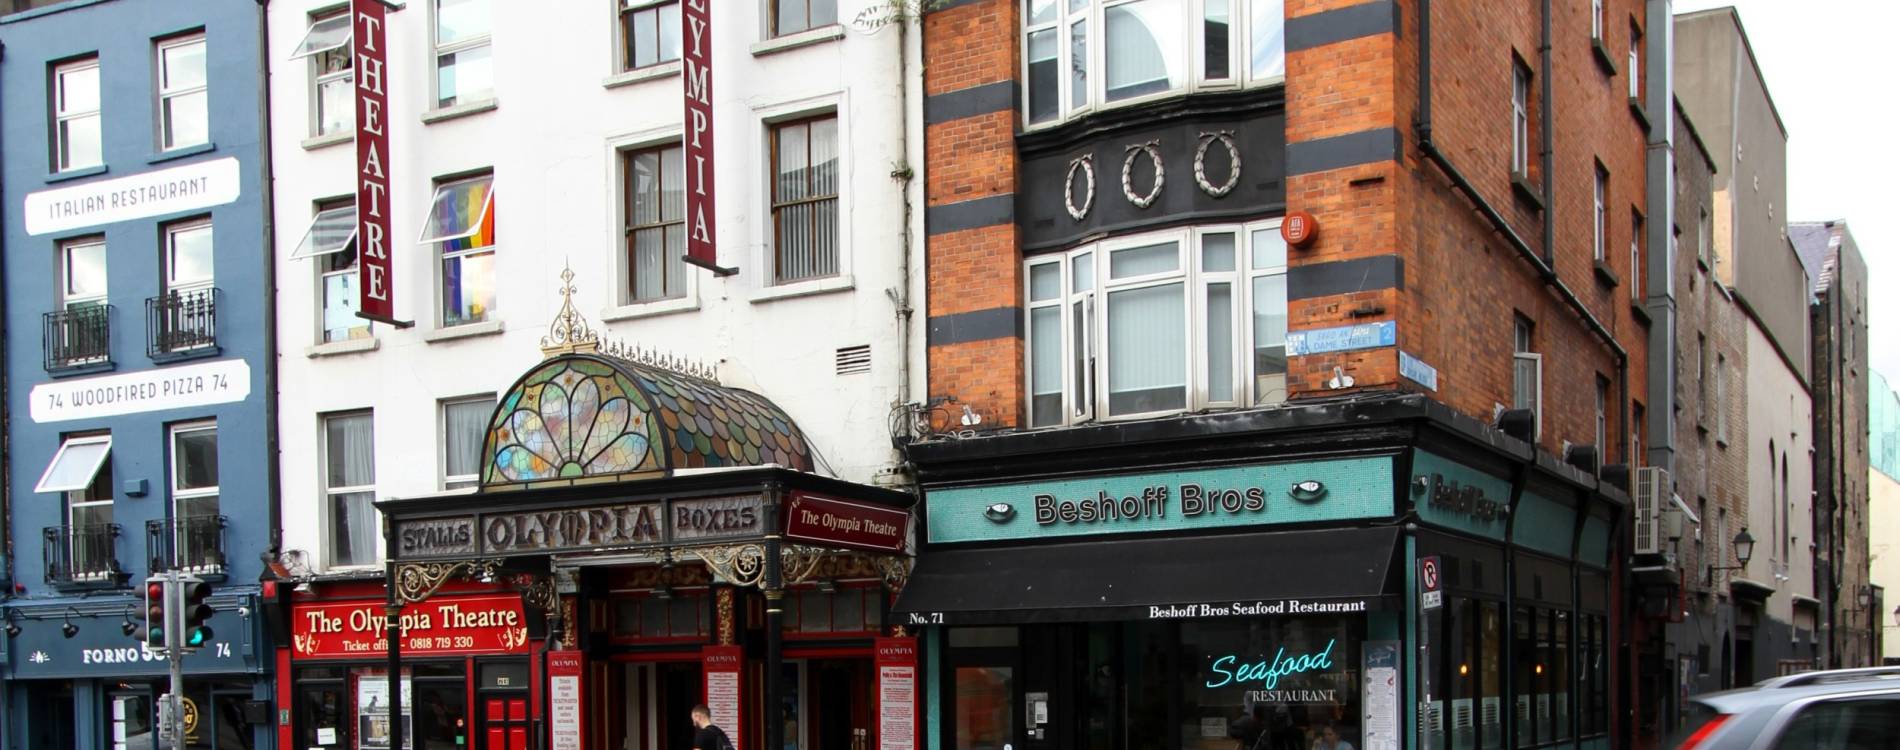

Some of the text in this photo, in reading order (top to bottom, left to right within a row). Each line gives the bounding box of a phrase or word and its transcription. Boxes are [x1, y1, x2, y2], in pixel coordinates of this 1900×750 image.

[359, 13, 388, 302] THEATRE
[50, 177, 208, 219] ITALIAN RESTAURANT
[1384, 328, 1392, 339] 2
[49, 374, 228, 409] 74 WOODFIRED PIZZA 74
[1034, 483, 1265, 525] Beshoff Bros
[403, 505, 756, 551] STALLS OLYMPIA BOXES
[801, 509, 897, 537] The Olympia Theatre
[306, 604, 518, 638] The Olypia Theatre
[909, 612, 944, 625] No. 71
[1149, 600, 1366, 619] Beshoff Bros Seafood Restaurant
[83, 647, 139, 664] FORNO
[216, 642, 231, 658] 74
[342, 640, 370, 652] Ticket
[410, 637, 432, 649] 0818
[435, 637, 451, 649] 719
[454, 636, 473, 648] 330
[1206, 638, 1335, 690] Seafood
[1252, 689, 1336, 702] RESTAURANT
